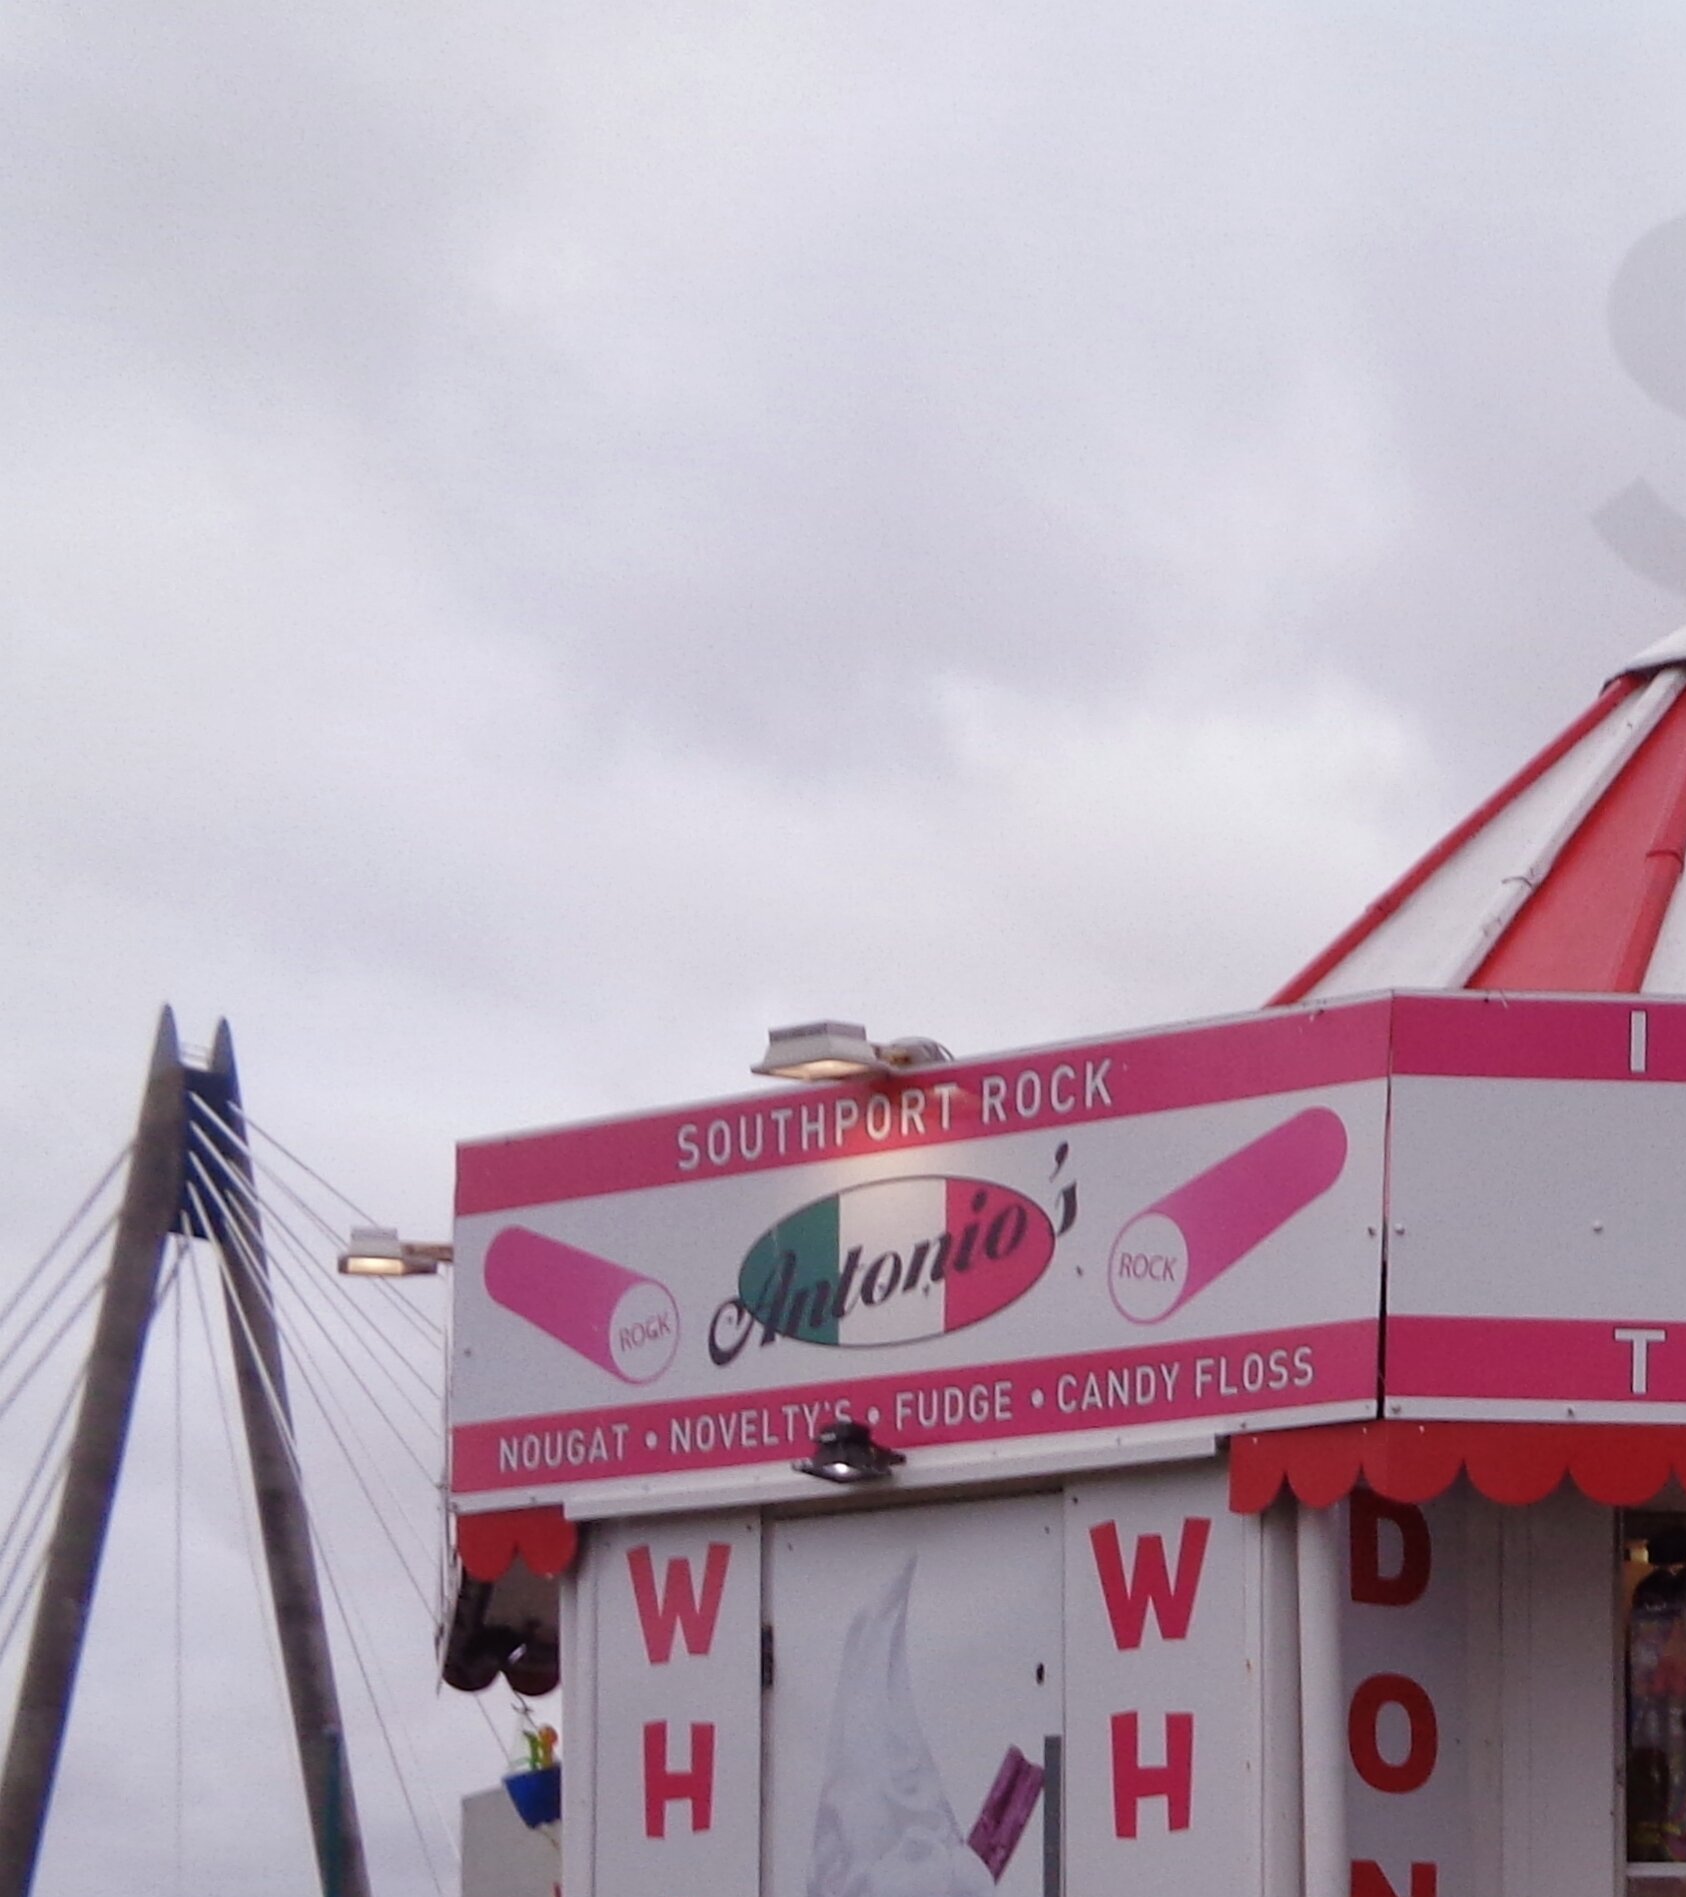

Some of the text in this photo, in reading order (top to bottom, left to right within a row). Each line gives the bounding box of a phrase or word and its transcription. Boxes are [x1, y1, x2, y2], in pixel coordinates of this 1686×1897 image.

[676, 1061, 1114, 1172] SOUTHPORT ROCK
[707, 1143, 1080, 1365] Antonio's
[1118, 1251, 1179, 1285] ROCK
[617, 1310, 673, 1352] ROCK
[497, 1346, 1316, 1472] NOUGAT NOVELTY'S FUDGE CANDY FLOSS
